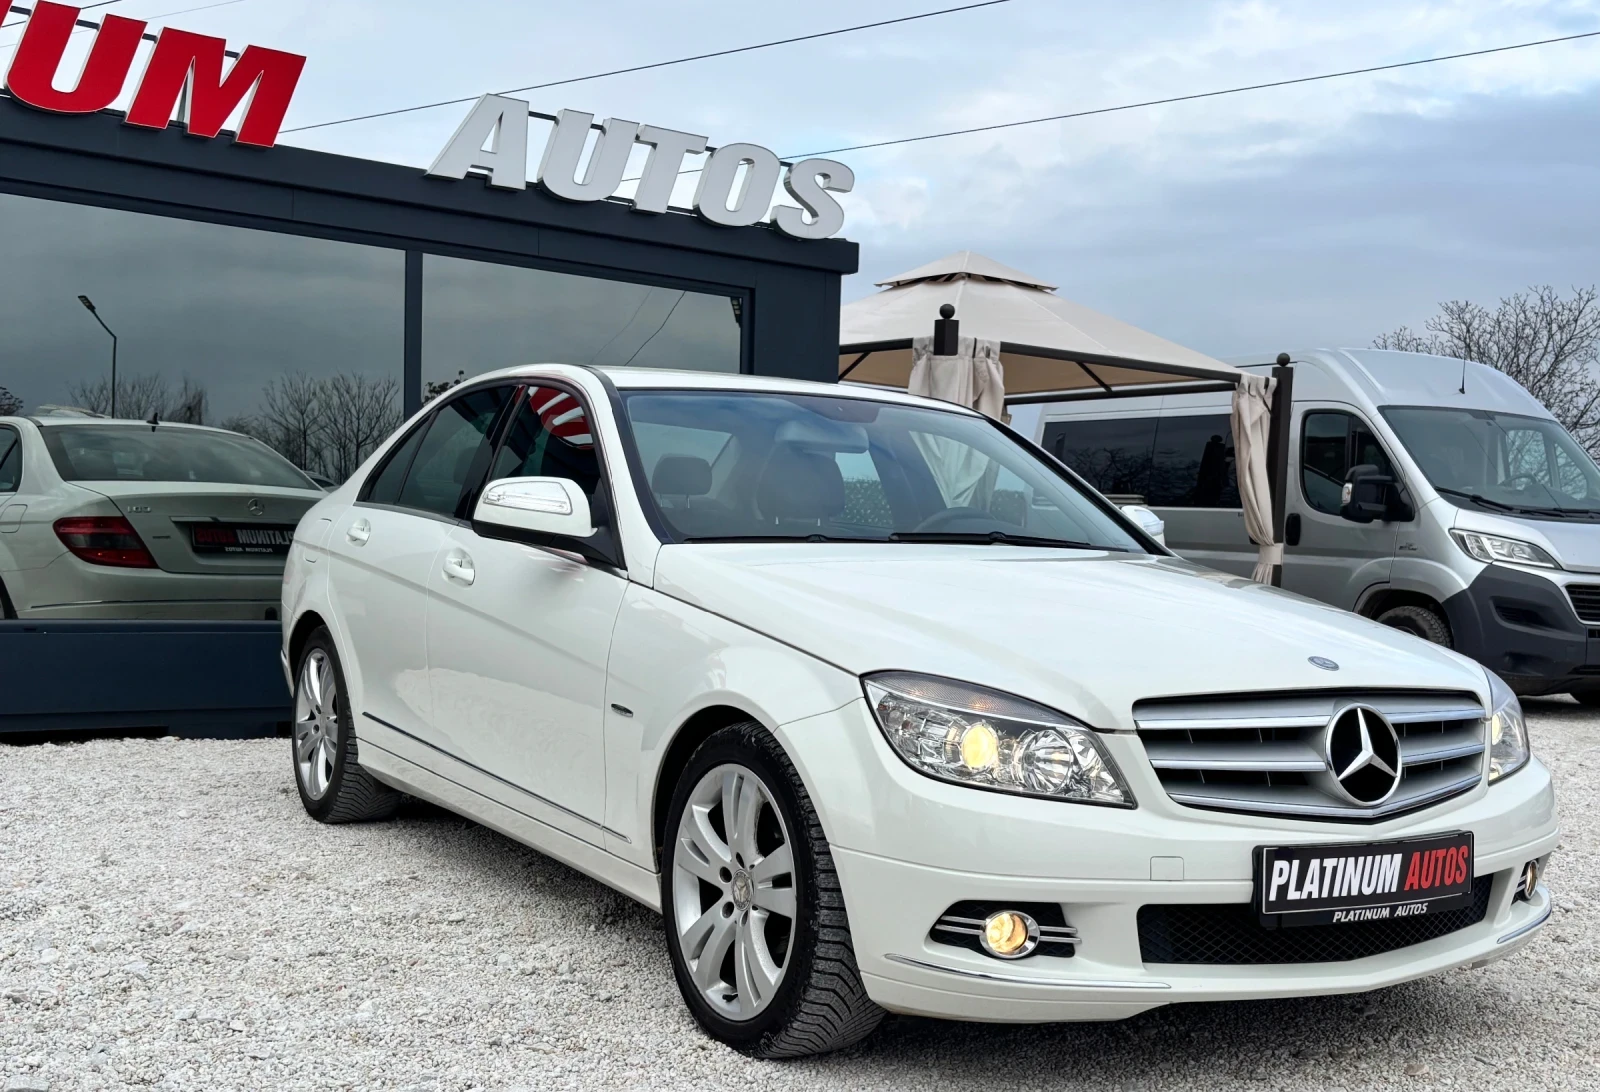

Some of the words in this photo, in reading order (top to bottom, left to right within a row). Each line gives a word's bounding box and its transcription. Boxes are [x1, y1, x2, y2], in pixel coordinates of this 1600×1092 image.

[0, 0, 306, 147] UM
[425, 93, 855, 239] AUTOS
[1269, 853, 1402, 901] PLATINUM
[1404, 845, 1468, 891] AUTOS
[1333, 907, 1389, 923] PLATINUM
[1394, 902, 1428, 917] AUTOS
